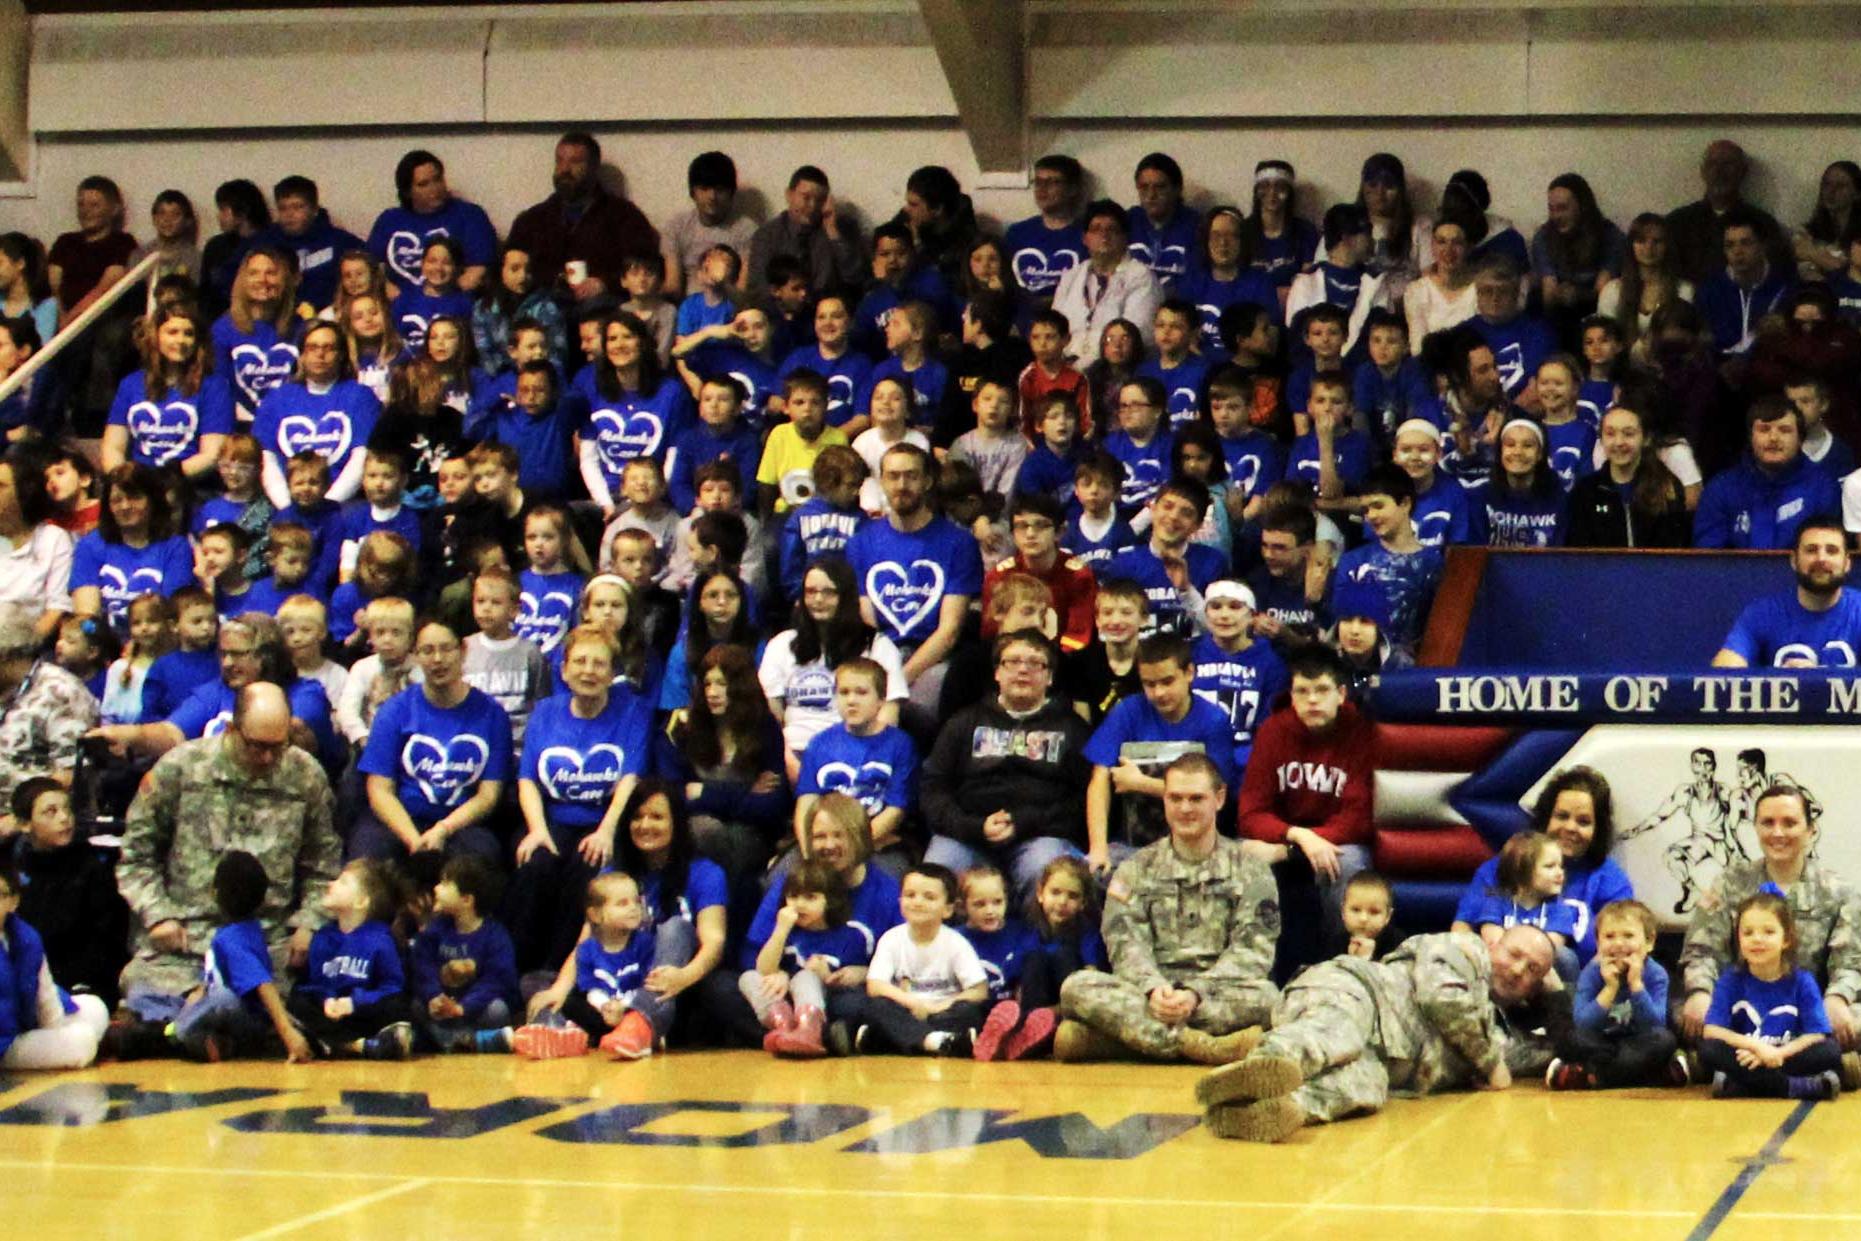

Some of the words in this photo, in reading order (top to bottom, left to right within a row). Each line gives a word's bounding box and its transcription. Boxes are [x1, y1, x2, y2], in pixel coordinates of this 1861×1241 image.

[1436, 675, 1579, 713] HOME
[1604, 675, 1668, 713] OF
[1693, 676, 1799, 713] THE
[972, 726, 1066, 763] BEAST
[551, 766, 619, 782] Mohawks
